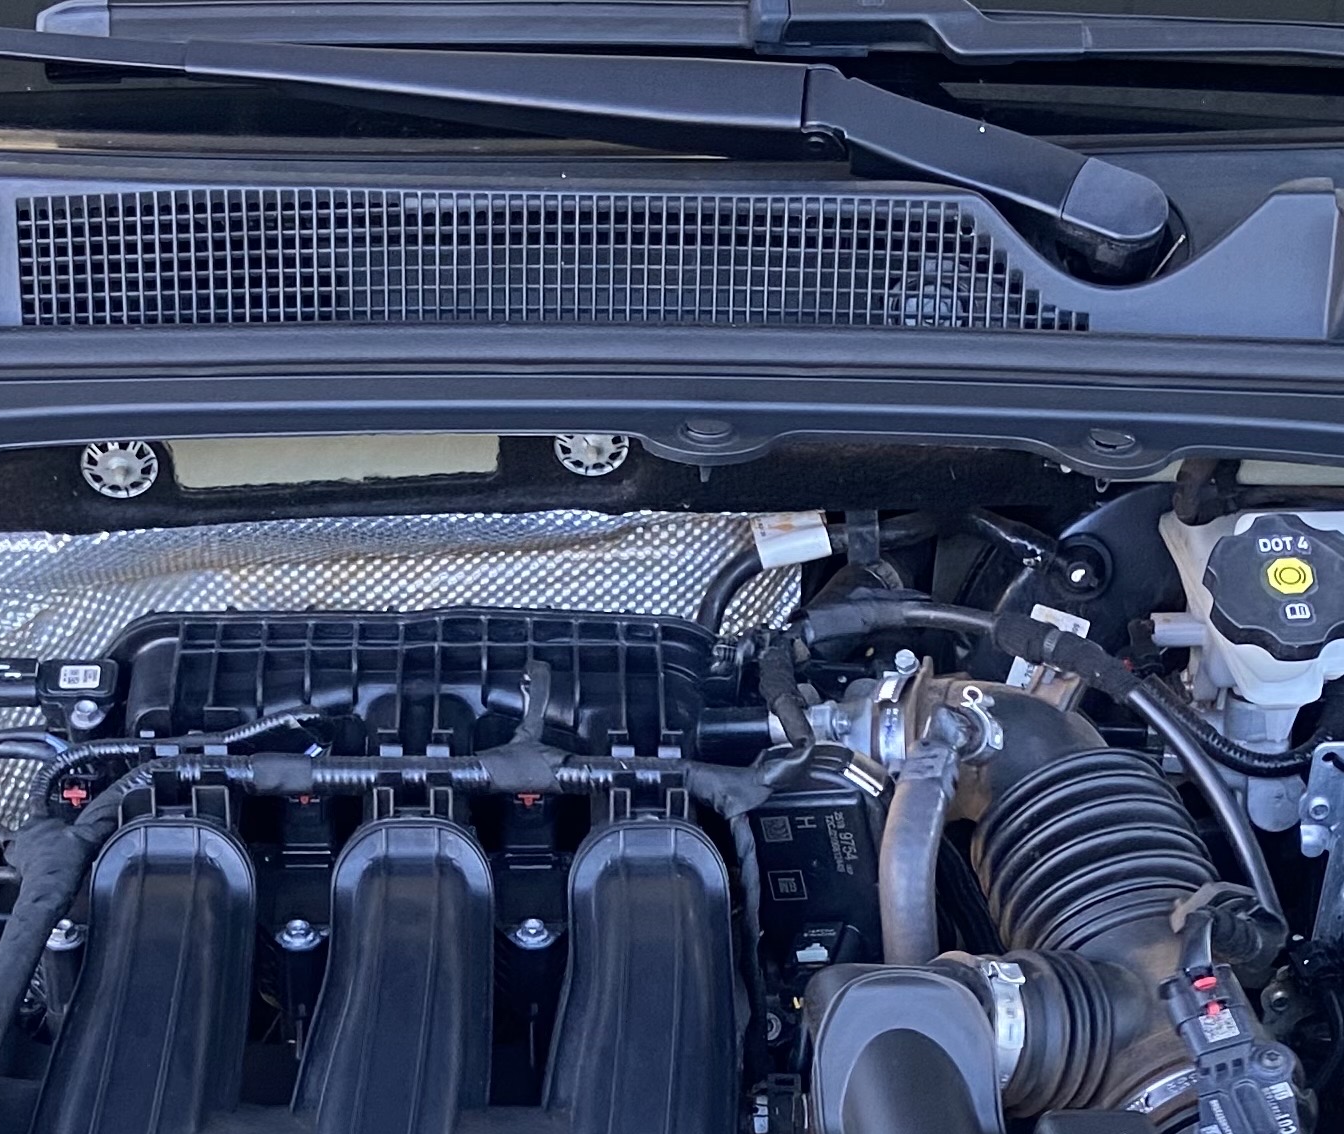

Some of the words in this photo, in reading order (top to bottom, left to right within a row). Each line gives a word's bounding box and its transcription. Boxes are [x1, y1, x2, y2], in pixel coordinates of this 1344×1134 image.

[1258, 537, 1293, 552] DOT
[1298, 536, 1309, 550] 4
[795, 816, 817, 829] H
[839, 832, 859, 861] 9754
